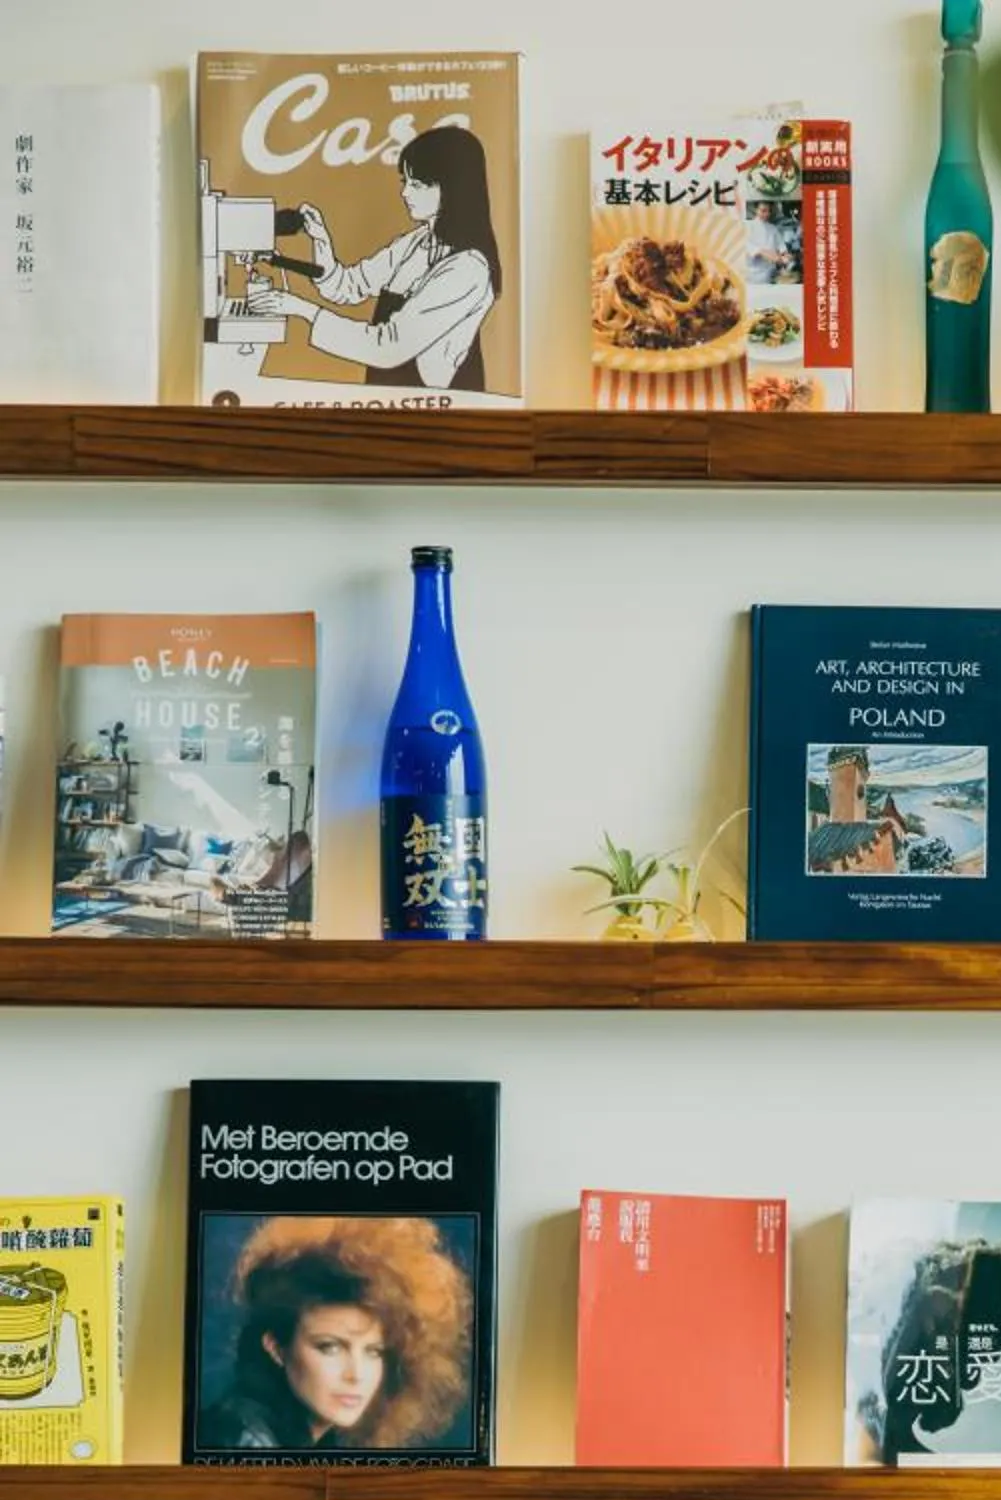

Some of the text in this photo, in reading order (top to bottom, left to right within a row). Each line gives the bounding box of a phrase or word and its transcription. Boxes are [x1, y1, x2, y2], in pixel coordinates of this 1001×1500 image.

[389, 82, 472, 103] BRUTUS
[242, 73, 468, 174] Cas
[602, 135, 793, 173] イタリアンの
[604, 179, 738, 206] 基本レシピ
[15, 134, 33, 293] 劇作家 坂元裕二
[133, 648, 249, 686] BEACH
[815, 660, 981, 679] ART, ARCHITECTURE
[831, 679, 964, 695] AND DESIGN IN
[135, 700, 241, 731] HOUSE
[849, 707, 946, 728] POLAND
[200, 1124, 409, 1152] Met Beroemde
[200, 1154, 453, 1185] Fotografen op Pad
[896, 1349, 951, 1405] 恋
